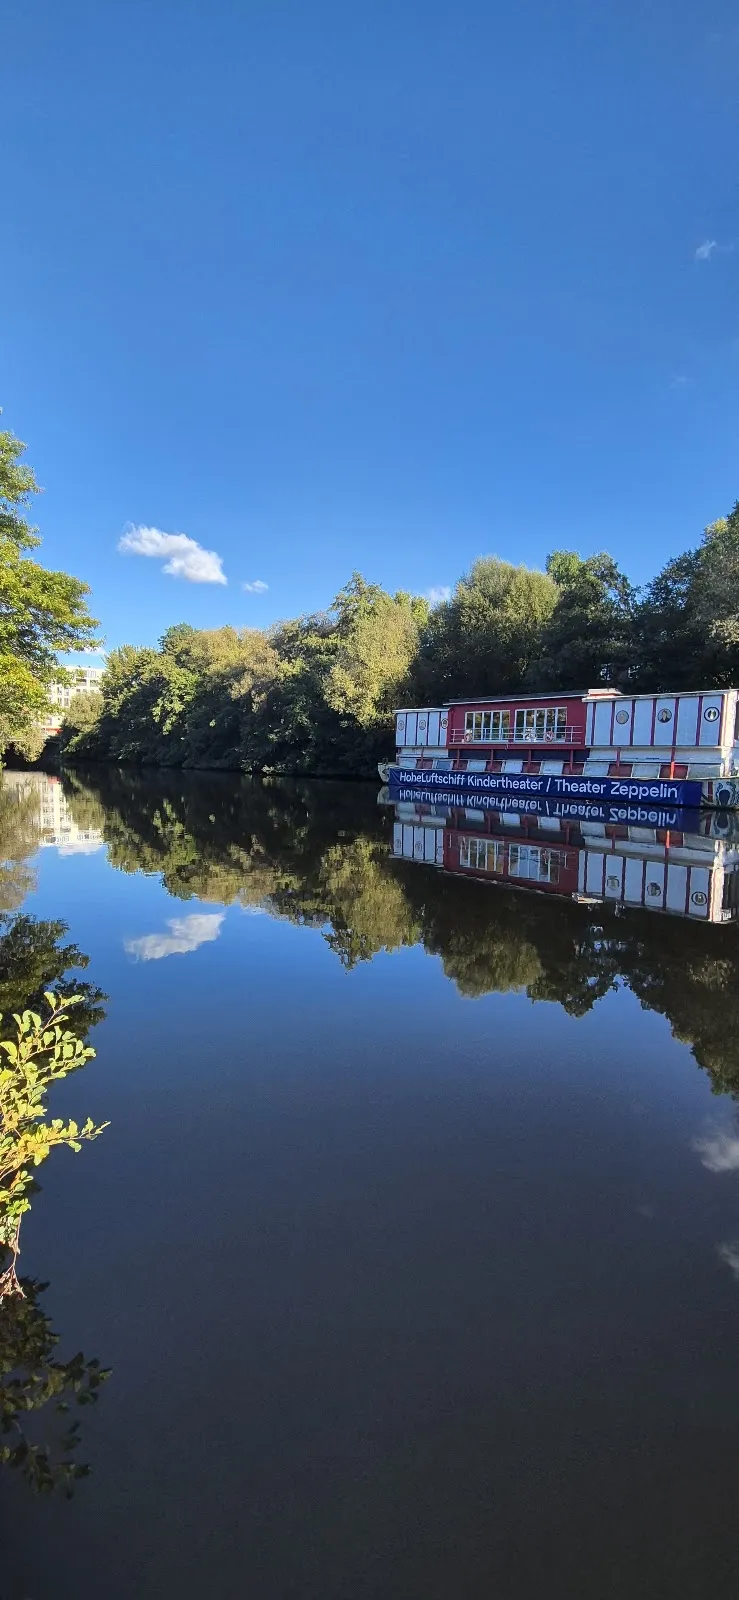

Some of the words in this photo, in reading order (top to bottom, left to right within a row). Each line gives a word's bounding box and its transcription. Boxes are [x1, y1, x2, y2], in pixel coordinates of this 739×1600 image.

[400, 771, 466, 785] HoheLuftschiff
[467, 775, 543, 790] Kindertheater
[545, 777, 552, 792] /
[555, 779, 607, 794] Theater
[610, 781, 678, 799] Zeppelin
